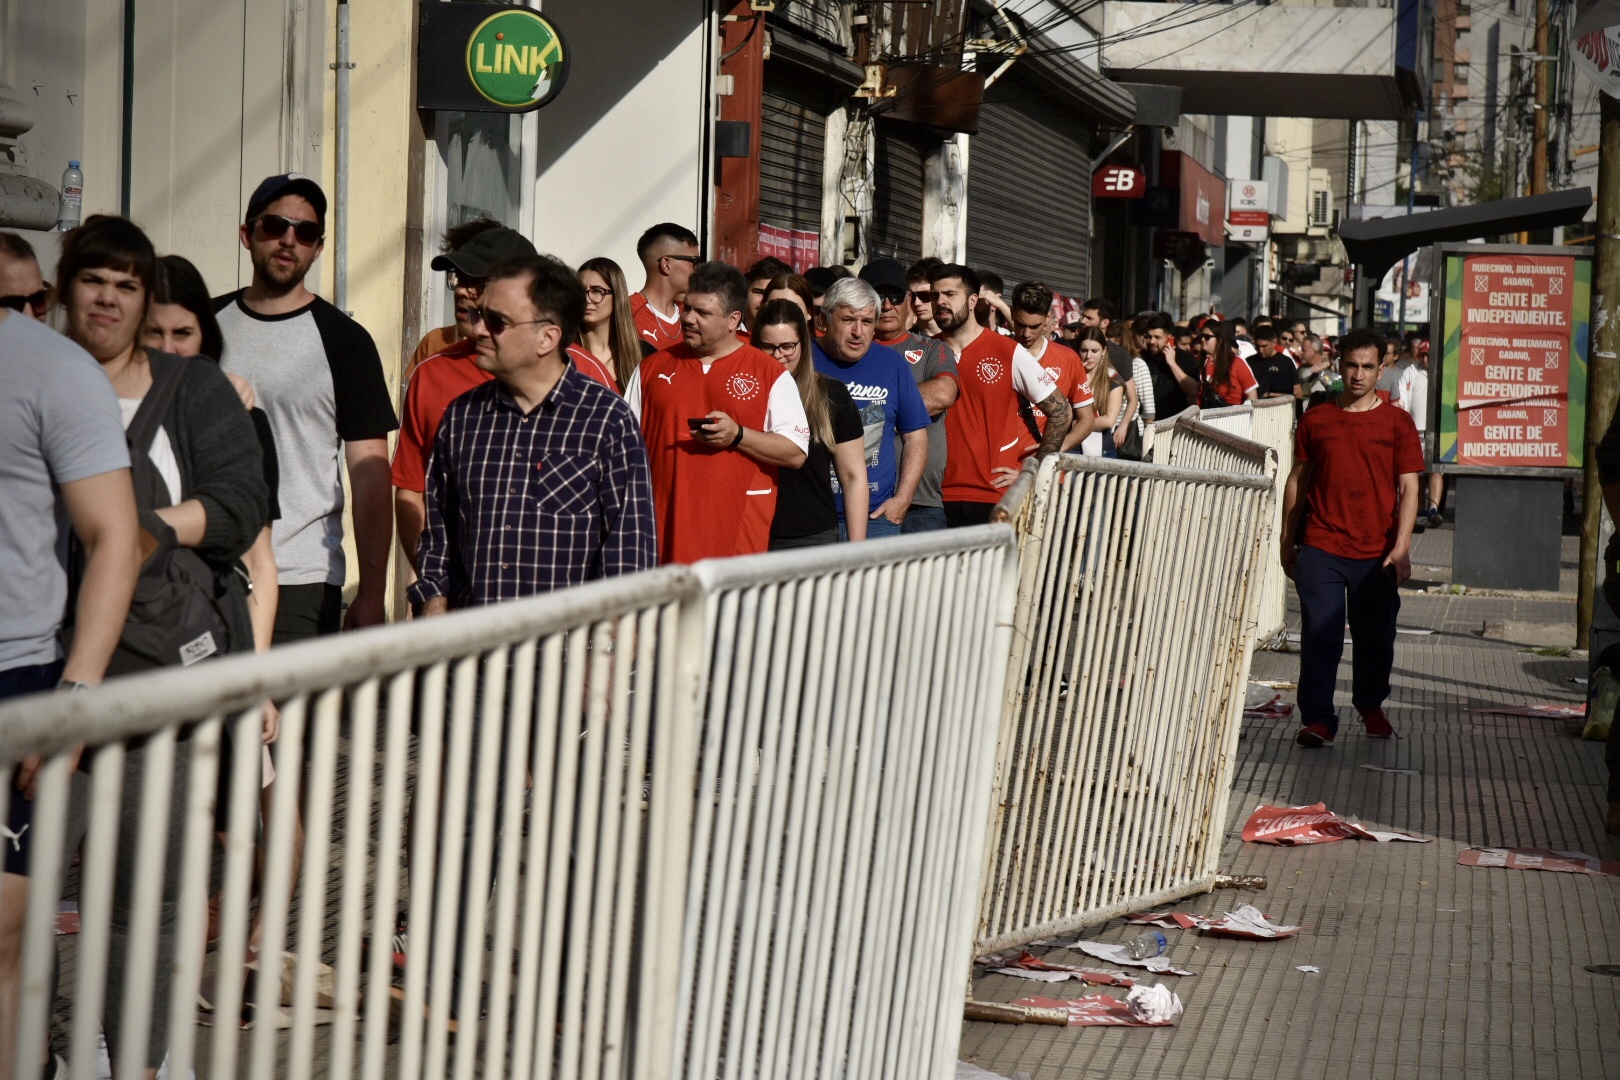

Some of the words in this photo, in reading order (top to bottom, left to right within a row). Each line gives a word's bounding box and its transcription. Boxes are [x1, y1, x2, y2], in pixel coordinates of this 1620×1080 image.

[476, 33, 556, 76] LINK
[1472, 263, 1514, 275] RUDECINDO,
[1516, 265, 1566, 276] BUSTAMANTE,
[1489, 292, 1528, 307] GENTE
[1531, 293, 1547, 308] DE
[1467, 308, 1566, 326] INDEPENDIENTE.
[1468, 336, 1510, 348] RUDECINDO,
[1512, 338, 1562, 350] BUSTAMANTE,
[1485, 365, 1524, 381] GENTE
[1527, 367, 1543, 382] DE
[1497, 410, 1528, 420] GADANO,
[1484, 425, 1523, 440] GENTE
[1526, 426, 1542, 440] DE
[1463, 442, 1562, 457] INDEPENDIENTE.
